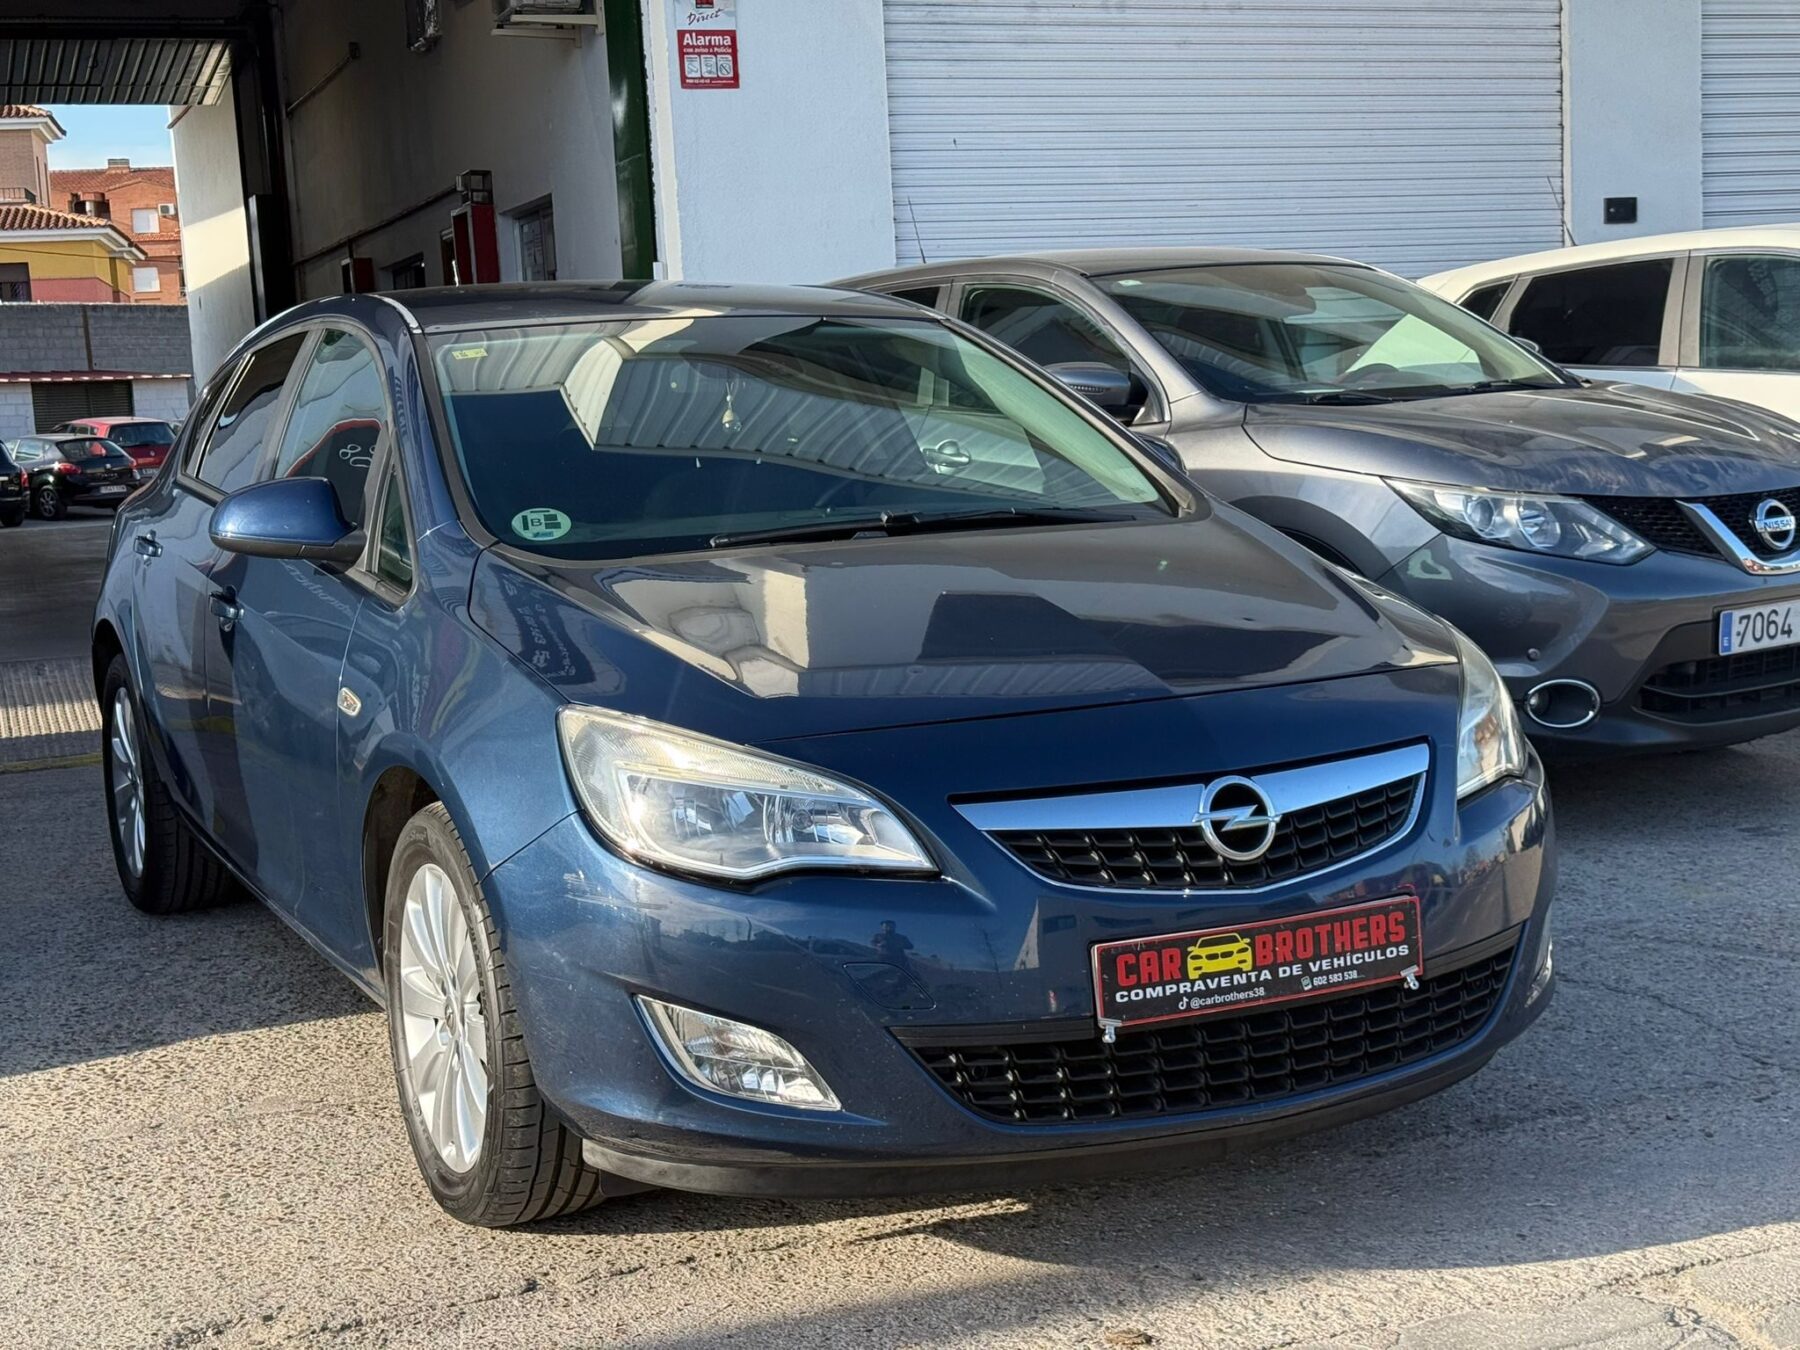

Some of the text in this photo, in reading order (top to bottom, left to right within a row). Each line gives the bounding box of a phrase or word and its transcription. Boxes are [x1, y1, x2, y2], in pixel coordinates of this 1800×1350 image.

[687, 8, 724, 26] Direct
[683, 32, 732, 46] Alarma
[531, 518, 543, 526] B
[1738, 608, 1793, 647] 7064
[1116, 911, 1406, 987] CAR BROTHERS
[1115, 945, 1409, 1003] COMPRAVENTA DE VEHÍCULOS
[1313, 975, 1327, 986] 602
[1329, 973, 1343, 984] 583
[1190, 987, 1265, 1009] @carbrothers38
